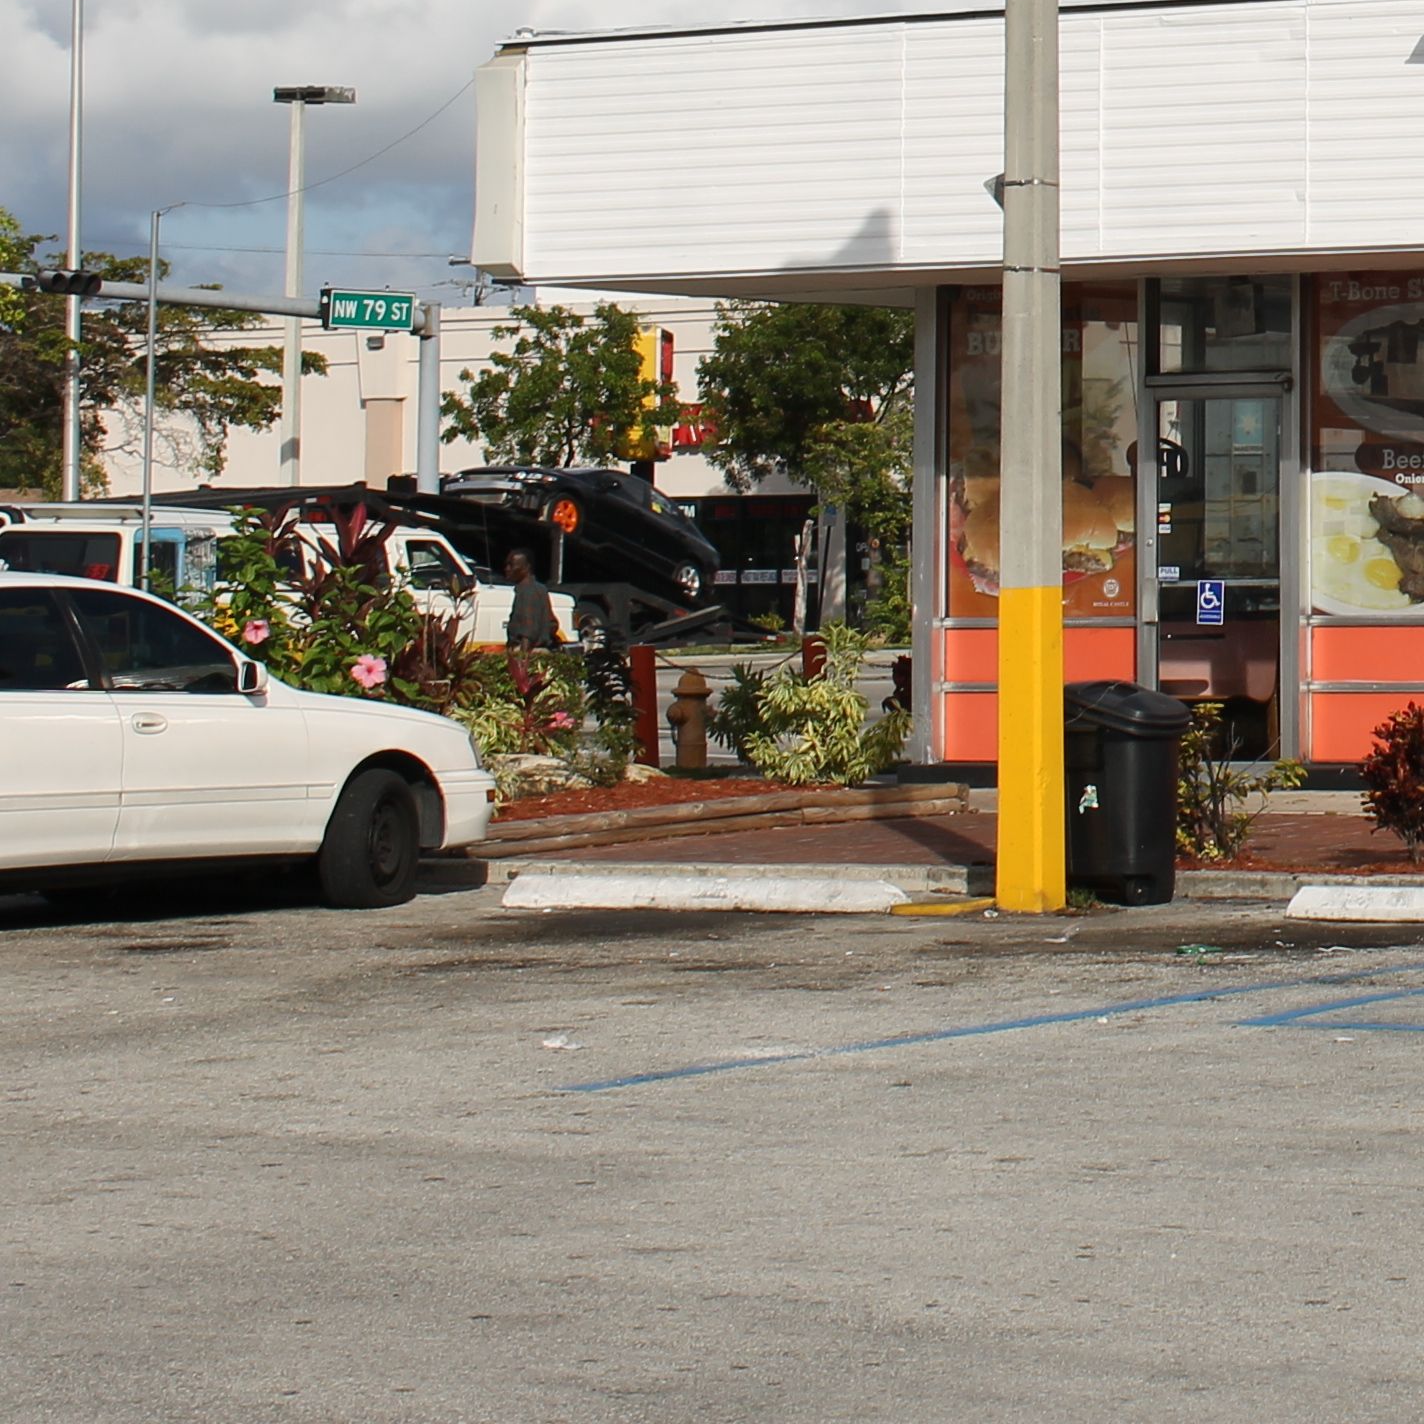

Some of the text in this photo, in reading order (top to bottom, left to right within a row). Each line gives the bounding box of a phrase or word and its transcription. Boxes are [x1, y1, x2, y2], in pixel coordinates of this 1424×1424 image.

[1330, 280, 1400, 301] T-Bone
[335, 299, 409, 321] NW 79 ST
[967, 329, 1080, 355] BUR
